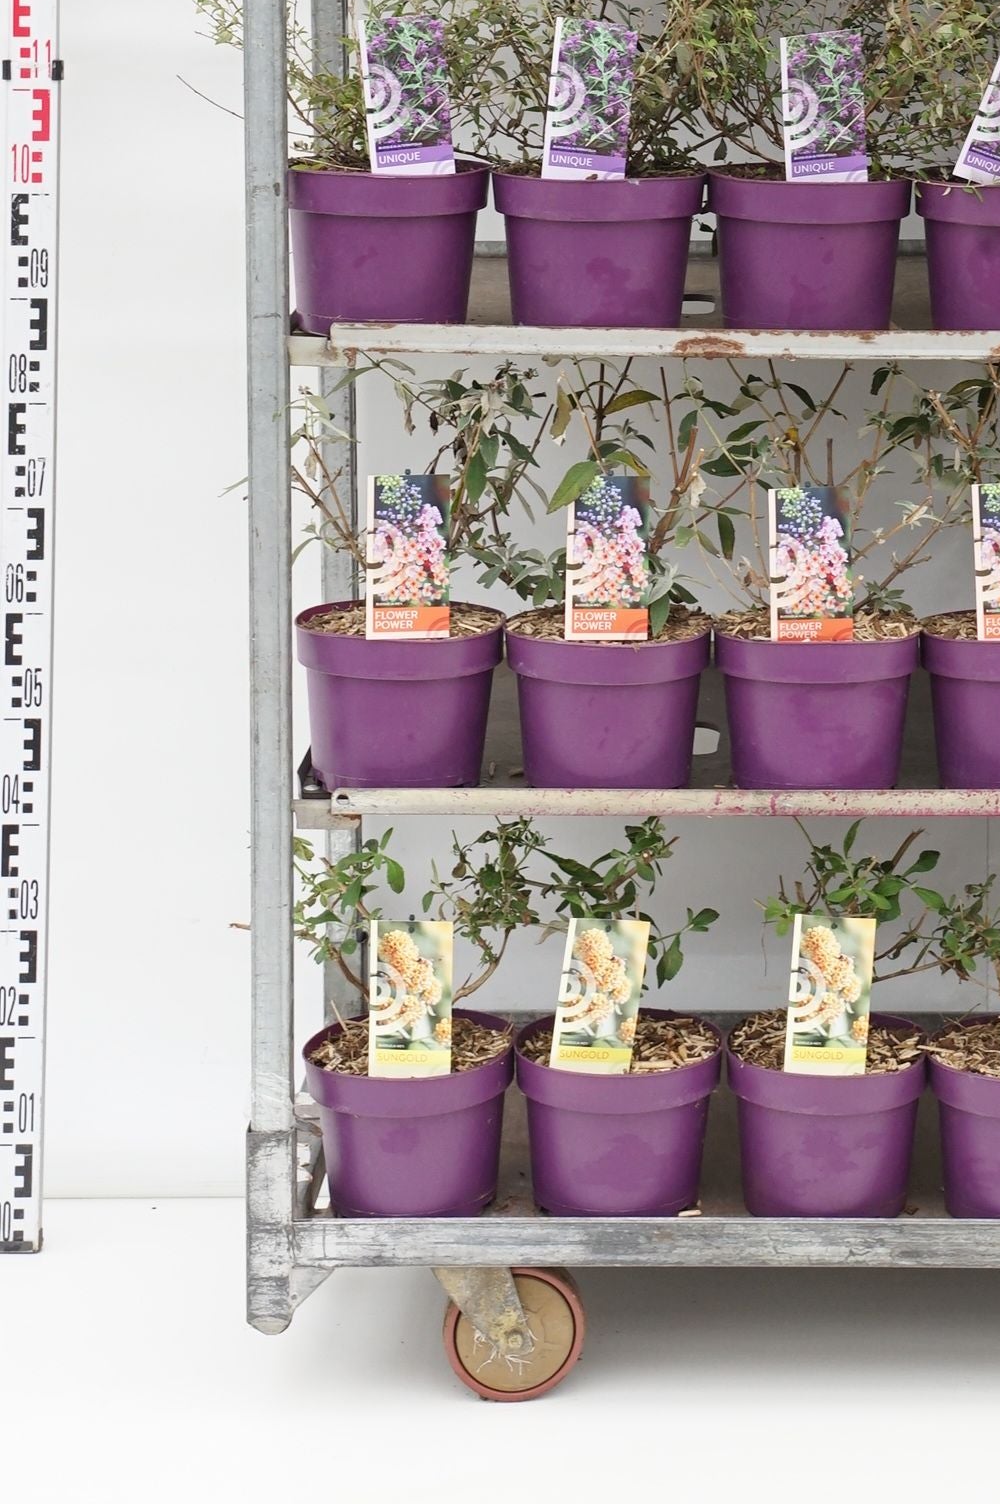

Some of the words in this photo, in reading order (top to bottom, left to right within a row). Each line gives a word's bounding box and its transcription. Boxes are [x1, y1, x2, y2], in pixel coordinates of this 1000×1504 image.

[11, 143, 30, 184] 10
[379, 152, 421, 165] UNIQUE
[550, 155, 593, 167] UNIQUE
[794, 161, 835, 174] UNIQUE
[30, 248, 48, 288] 09
[8, 353, 27, 393] 08
[27, 457, 47, 498] 07
[6, 562, 24, 603] 06
[375, 611, 418, 620] FLOWER
[573, 612, 617, 621] FLOWER
[375, 620, 414, 629] POWER
[573, 621, 613, 631] POWER
[780, 622, 823, 631] FLOWER
[780, 631, 818, 640] POWER
[24, 668, 43, 708] 05
[2, 774, 20, 814] 04
[20, 879, 39, 920] 03
[377, 1052, 428, 1063] SUNGOLD
[559, 1049, 610, 1060] SUNGOLD
[793, 1050, 844, 1061] SUNGOLD
[18, 1092, 34, 1133] 01
